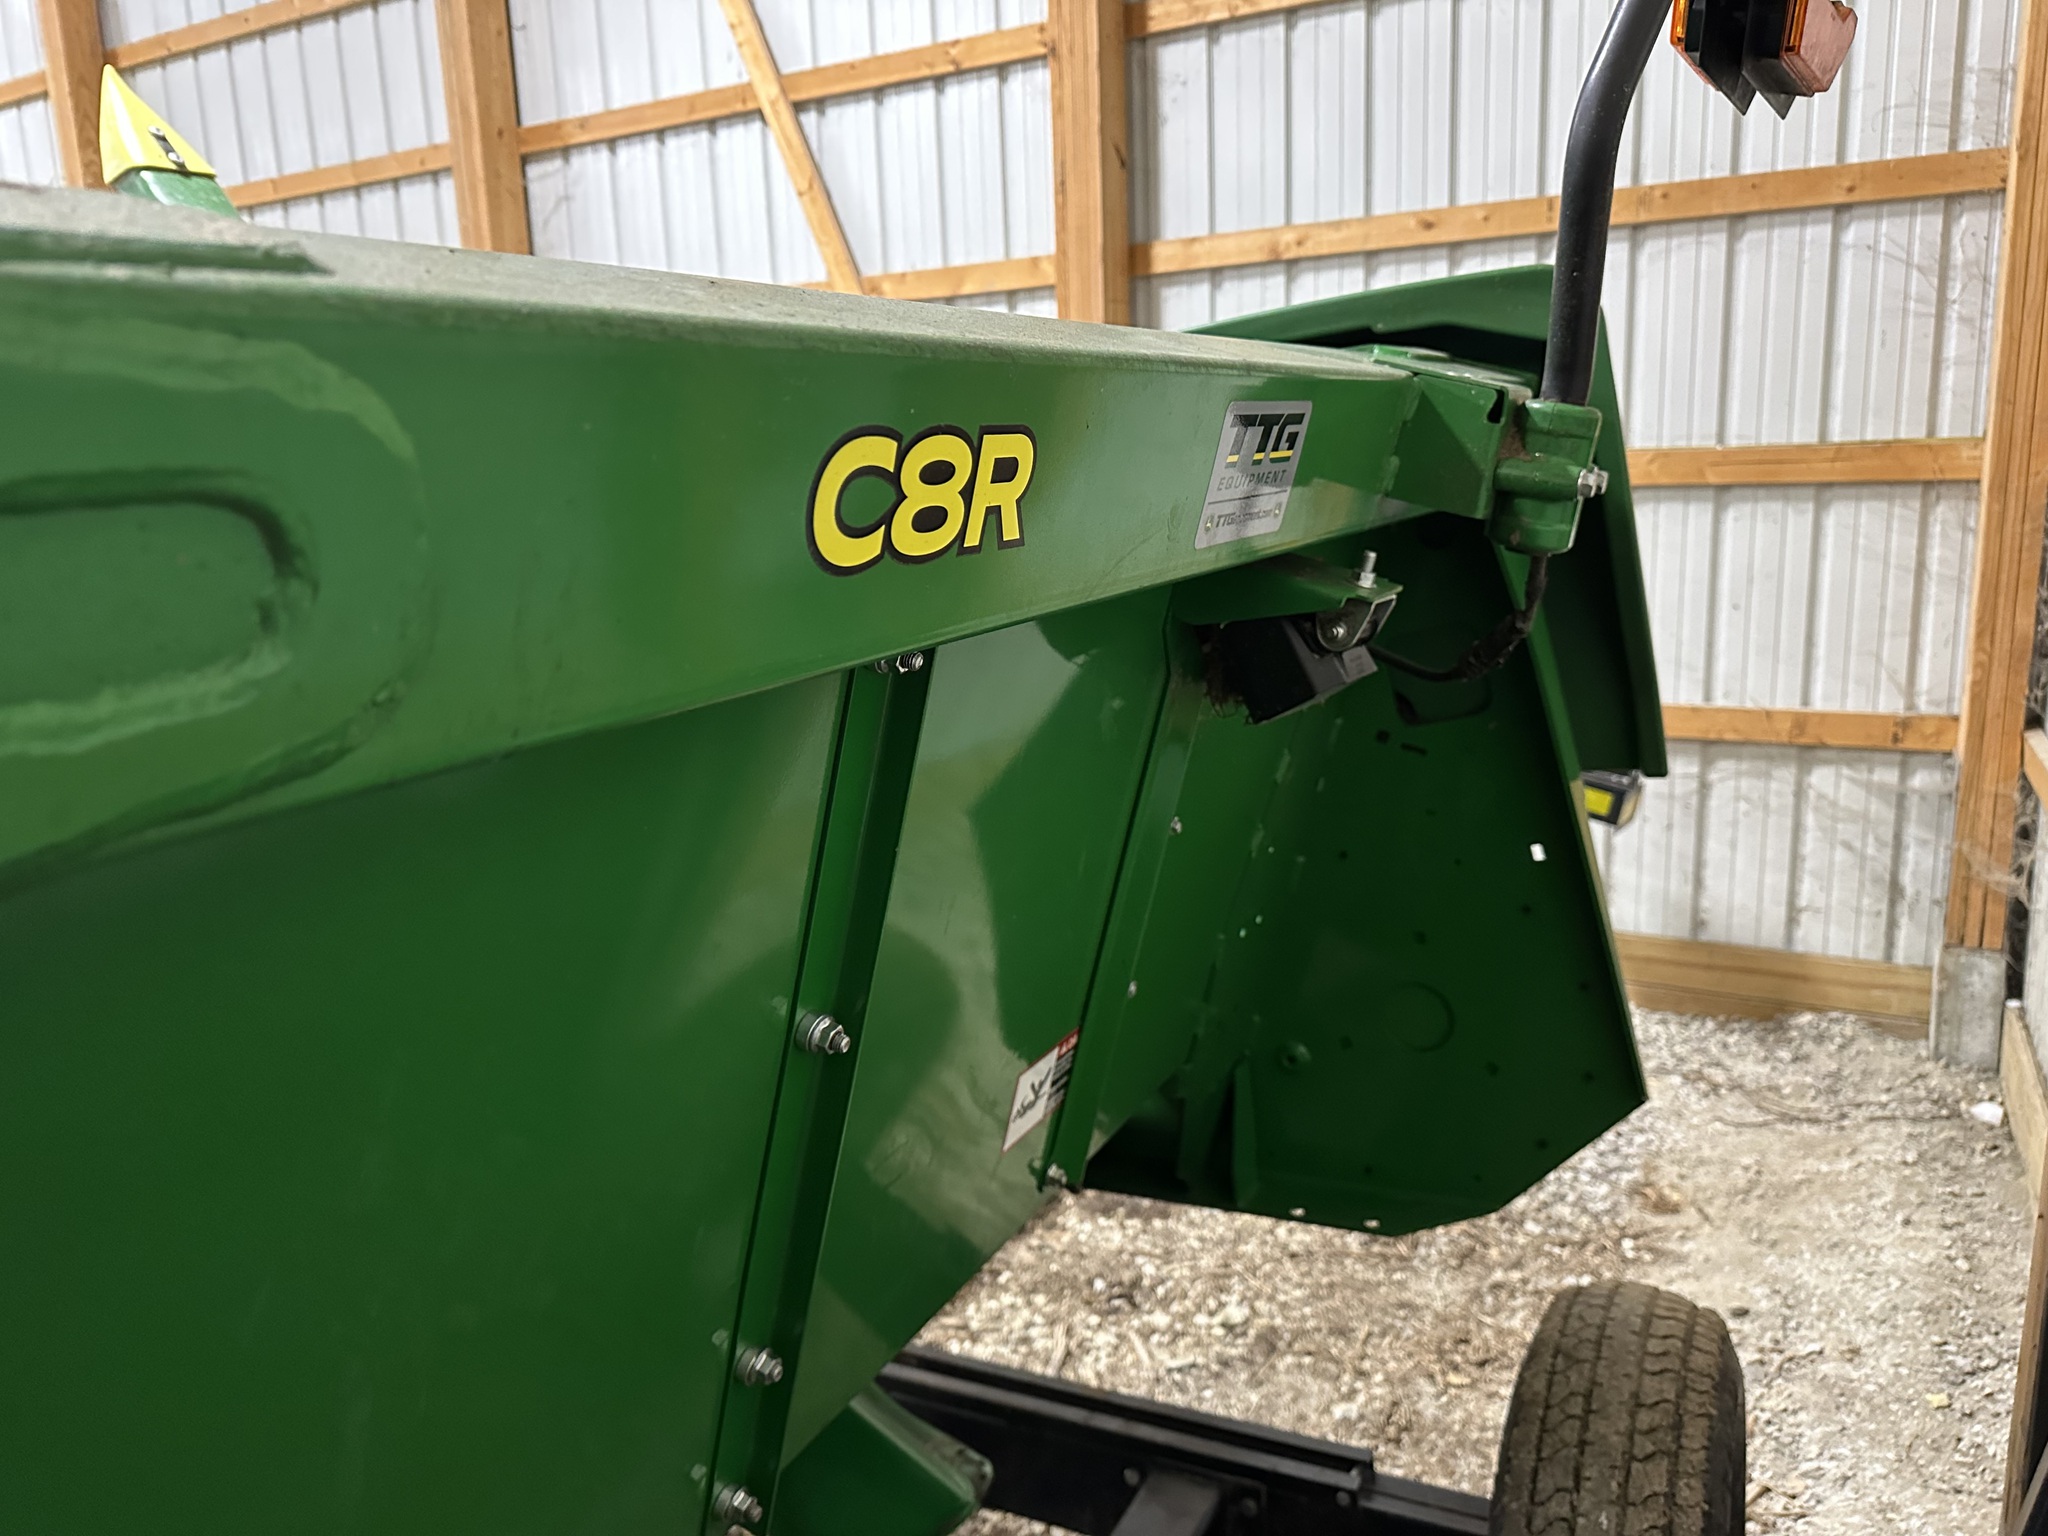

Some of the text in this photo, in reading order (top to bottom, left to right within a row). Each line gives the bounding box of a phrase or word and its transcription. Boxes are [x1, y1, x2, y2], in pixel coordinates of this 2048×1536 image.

[1225, 413, 1306, 468] TTG
[809, 428, 1035, 573] C8R
[1217, 469, 1287, 492] EQUIPMENT
